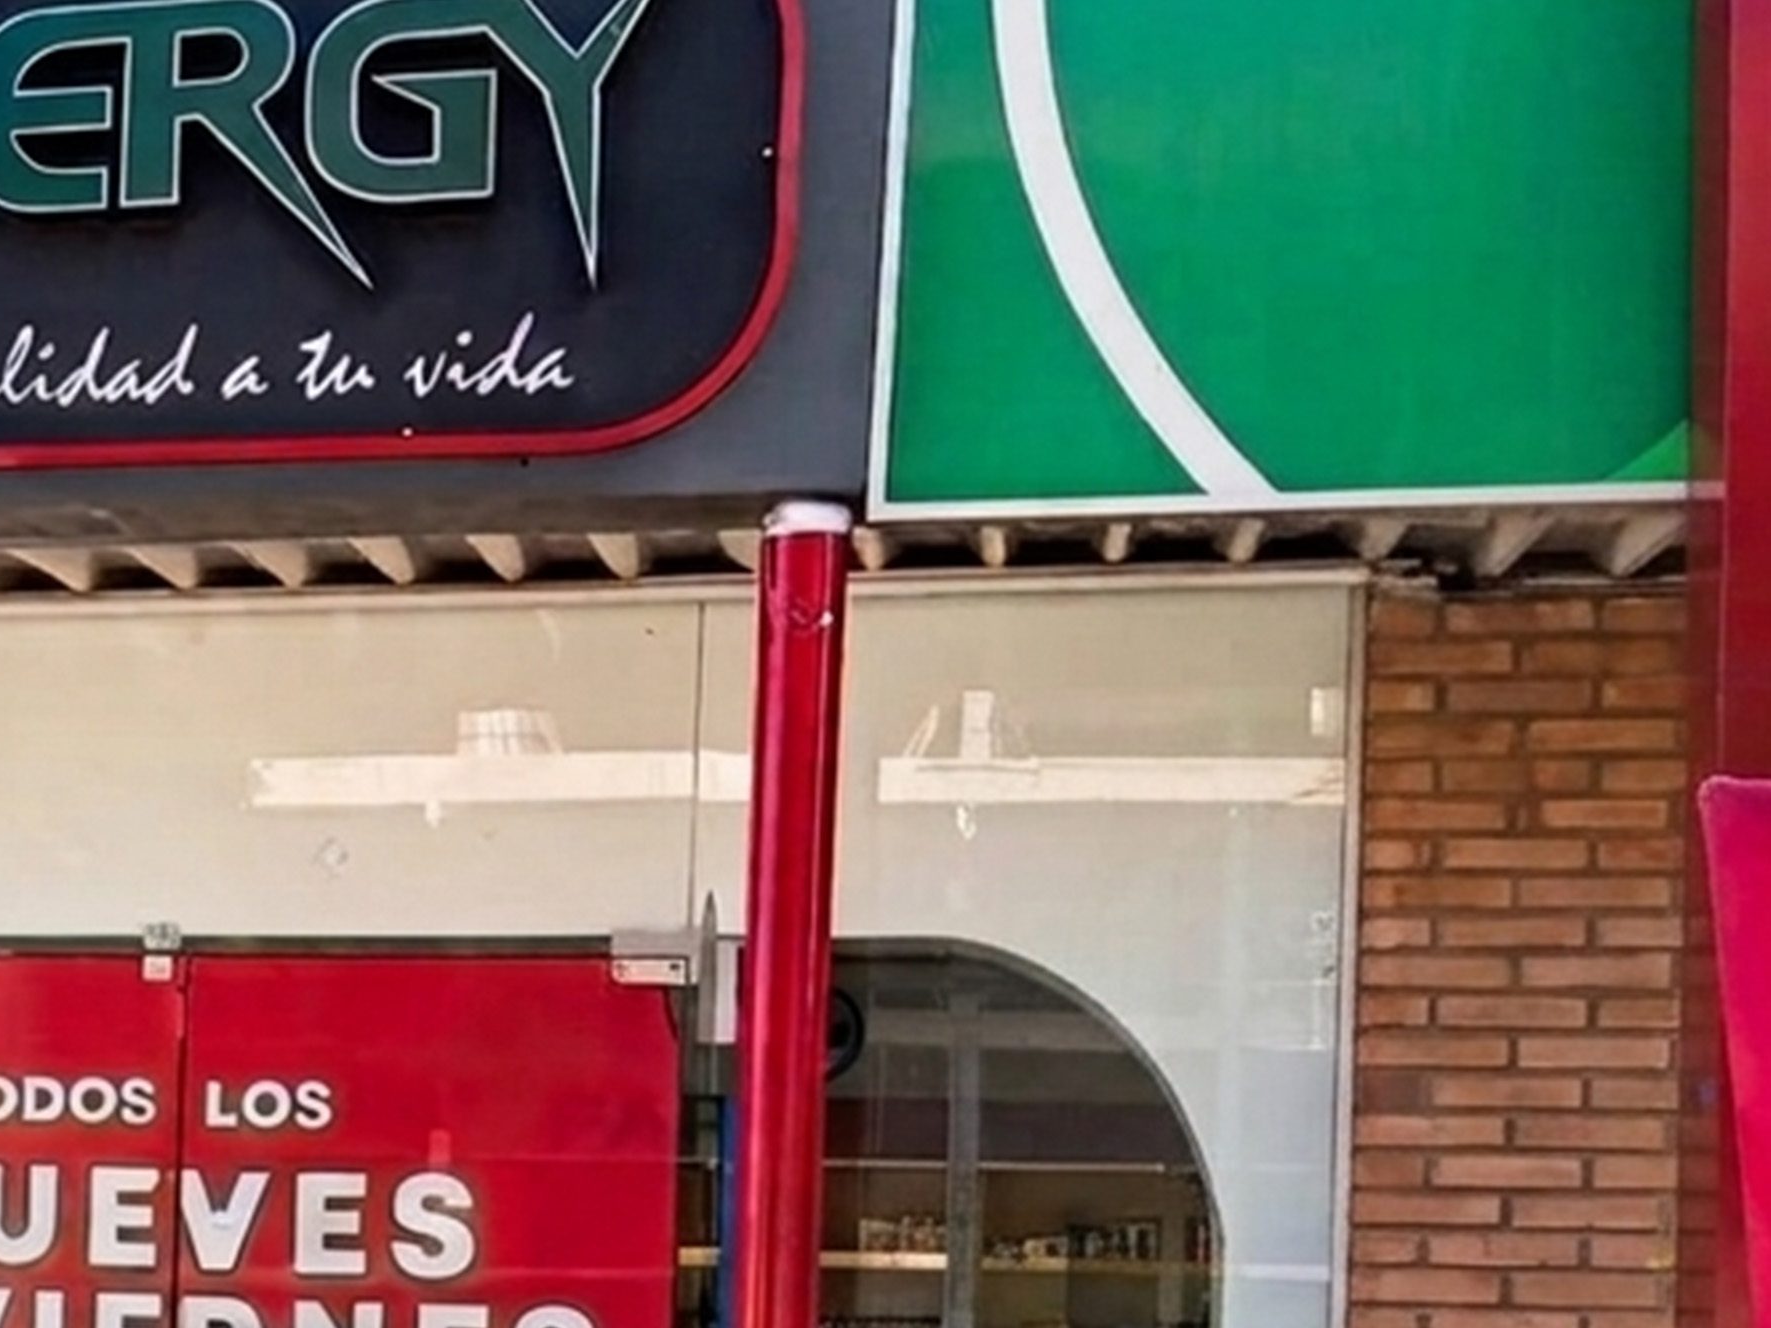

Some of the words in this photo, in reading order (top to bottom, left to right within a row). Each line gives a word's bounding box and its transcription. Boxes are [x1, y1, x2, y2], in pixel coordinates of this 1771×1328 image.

[221, 355, 269, 400] a
[296, 330, 376, 400] tu
[404, 311, 575, 398] vida
[205, 1080, 333, 1129] LOS
